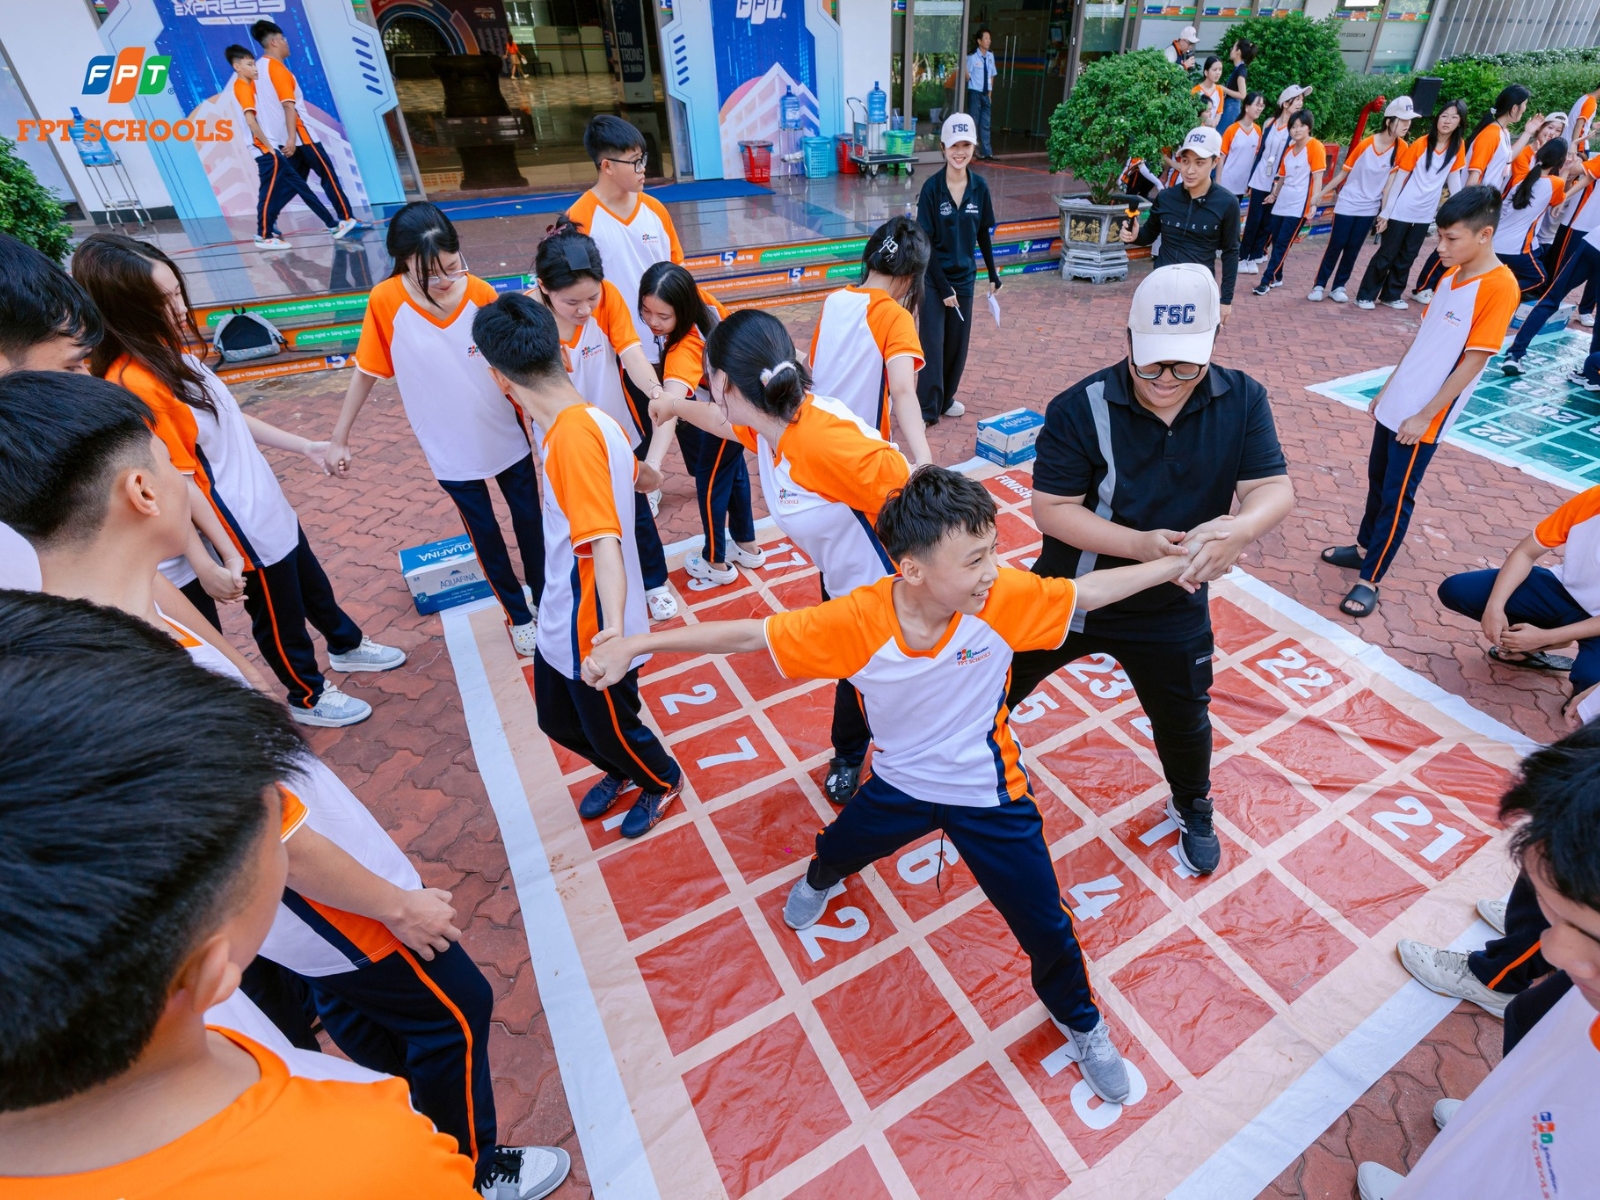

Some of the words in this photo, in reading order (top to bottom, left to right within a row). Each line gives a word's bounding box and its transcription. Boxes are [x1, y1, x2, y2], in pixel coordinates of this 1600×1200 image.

[952, 123, 969, 134] FSC
[1188, 133, 1206, 143] FSC
[723, 251, 734, 266] 5
[527, 274, 538, 288] 3
[793, 268, 801, 282] 5
[1153, 303, 1196, 325] FSC
[331, 355, 346, 368] 5
[1531, 405, 1581, 423] 20
[1469, 424, 1522, 444] 22
[995, 475, 1032, 499] FINISH
[761, 542, 808, 571] 17
[440, 573, 478, 589] AQUAFINA
[1062, 652, 1134, 699] 23
[1256, 648, 1333, 699] 22
[659, 683, 717, 716] 2
[696, 735, 759, 770] 7
[1371, 795, 1467, 863] 21
[896, 838, 959, 885] 6
[1068, 874, 1124, 922] 4
